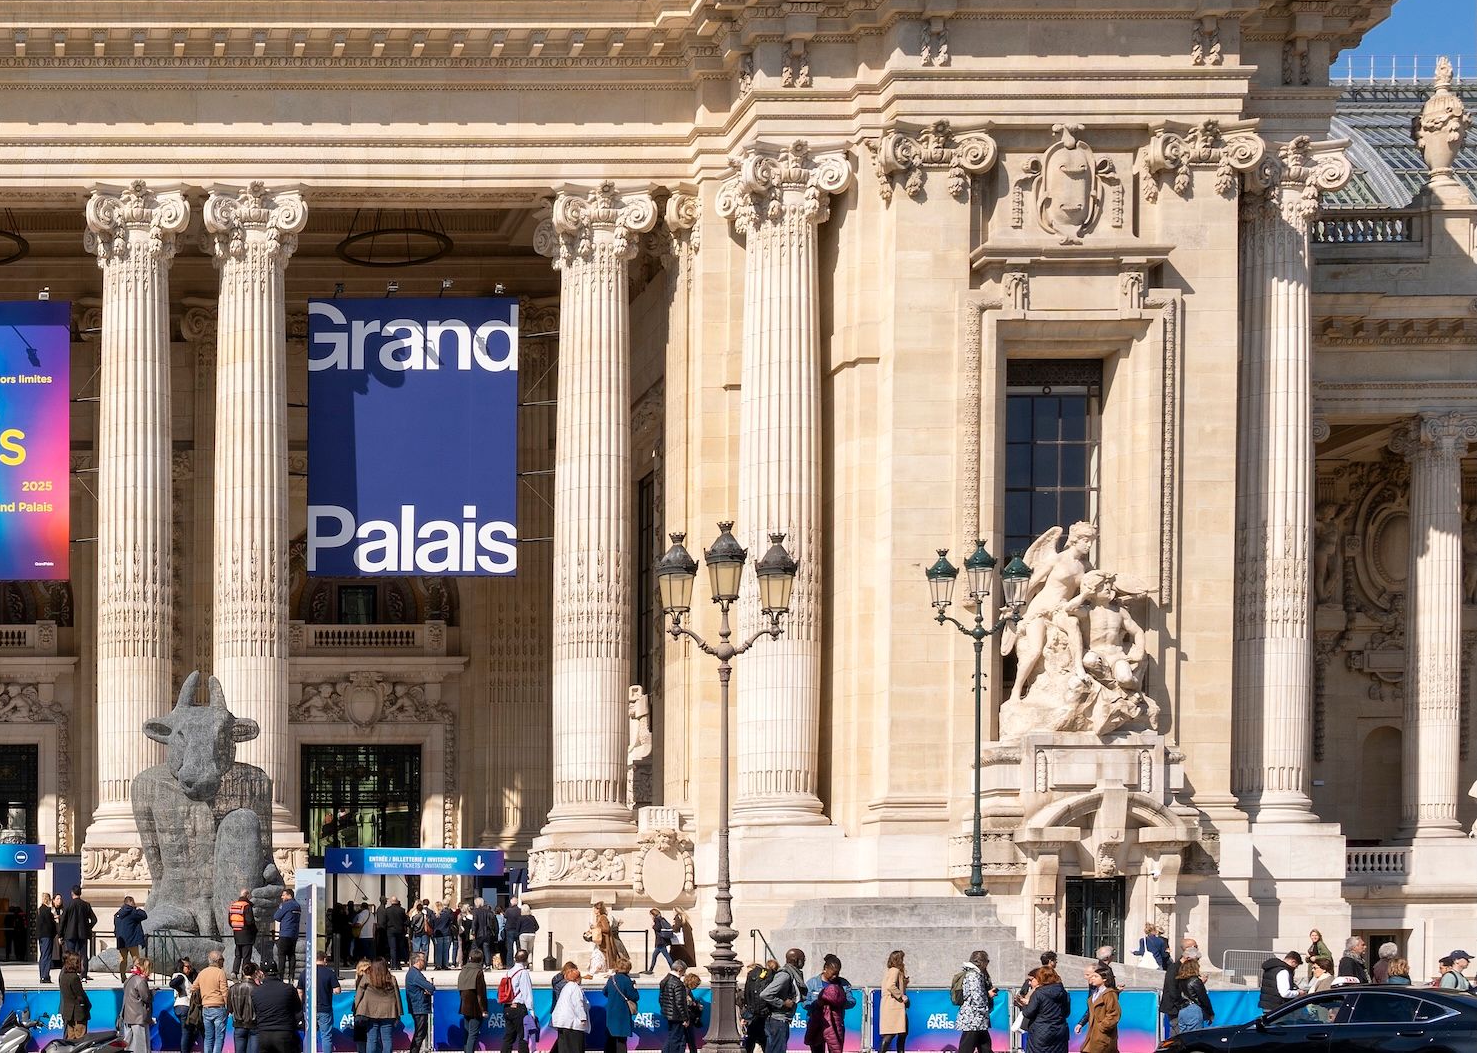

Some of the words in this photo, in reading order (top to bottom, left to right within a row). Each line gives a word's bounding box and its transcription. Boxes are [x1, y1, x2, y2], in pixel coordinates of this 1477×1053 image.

[308, 302, 519, 372] Grand
[18, 375, 52, 384] limites
[22, 482, 52, 492] 2025
[18, 502, 52, 513] Palais
[307, 504, 517, 574] Palais
[927, 1021, 954, 1029] PARIS
